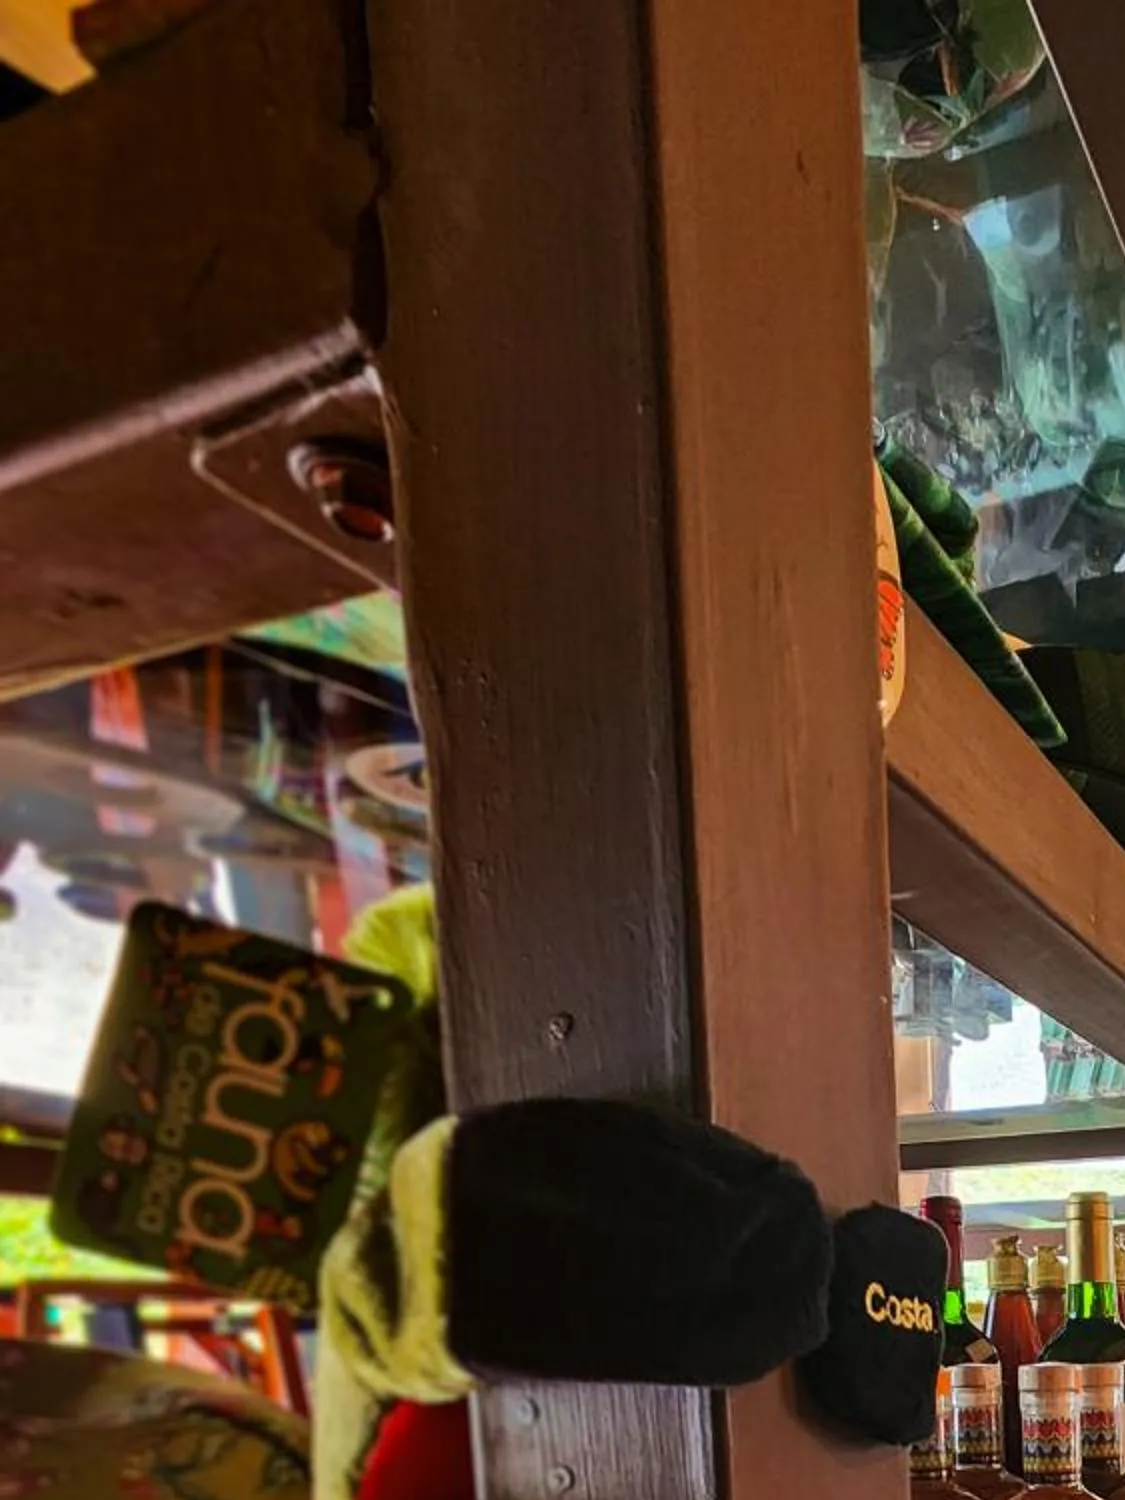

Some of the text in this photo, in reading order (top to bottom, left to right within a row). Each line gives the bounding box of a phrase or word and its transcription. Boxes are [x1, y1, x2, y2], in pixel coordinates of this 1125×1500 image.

[156, 1043, 211, 1148] Costa
[175, 961, 305, 1259] fauna
[136, 1153, 184, 1233] Rica
[864, 1281, 934, 1333] Costa
